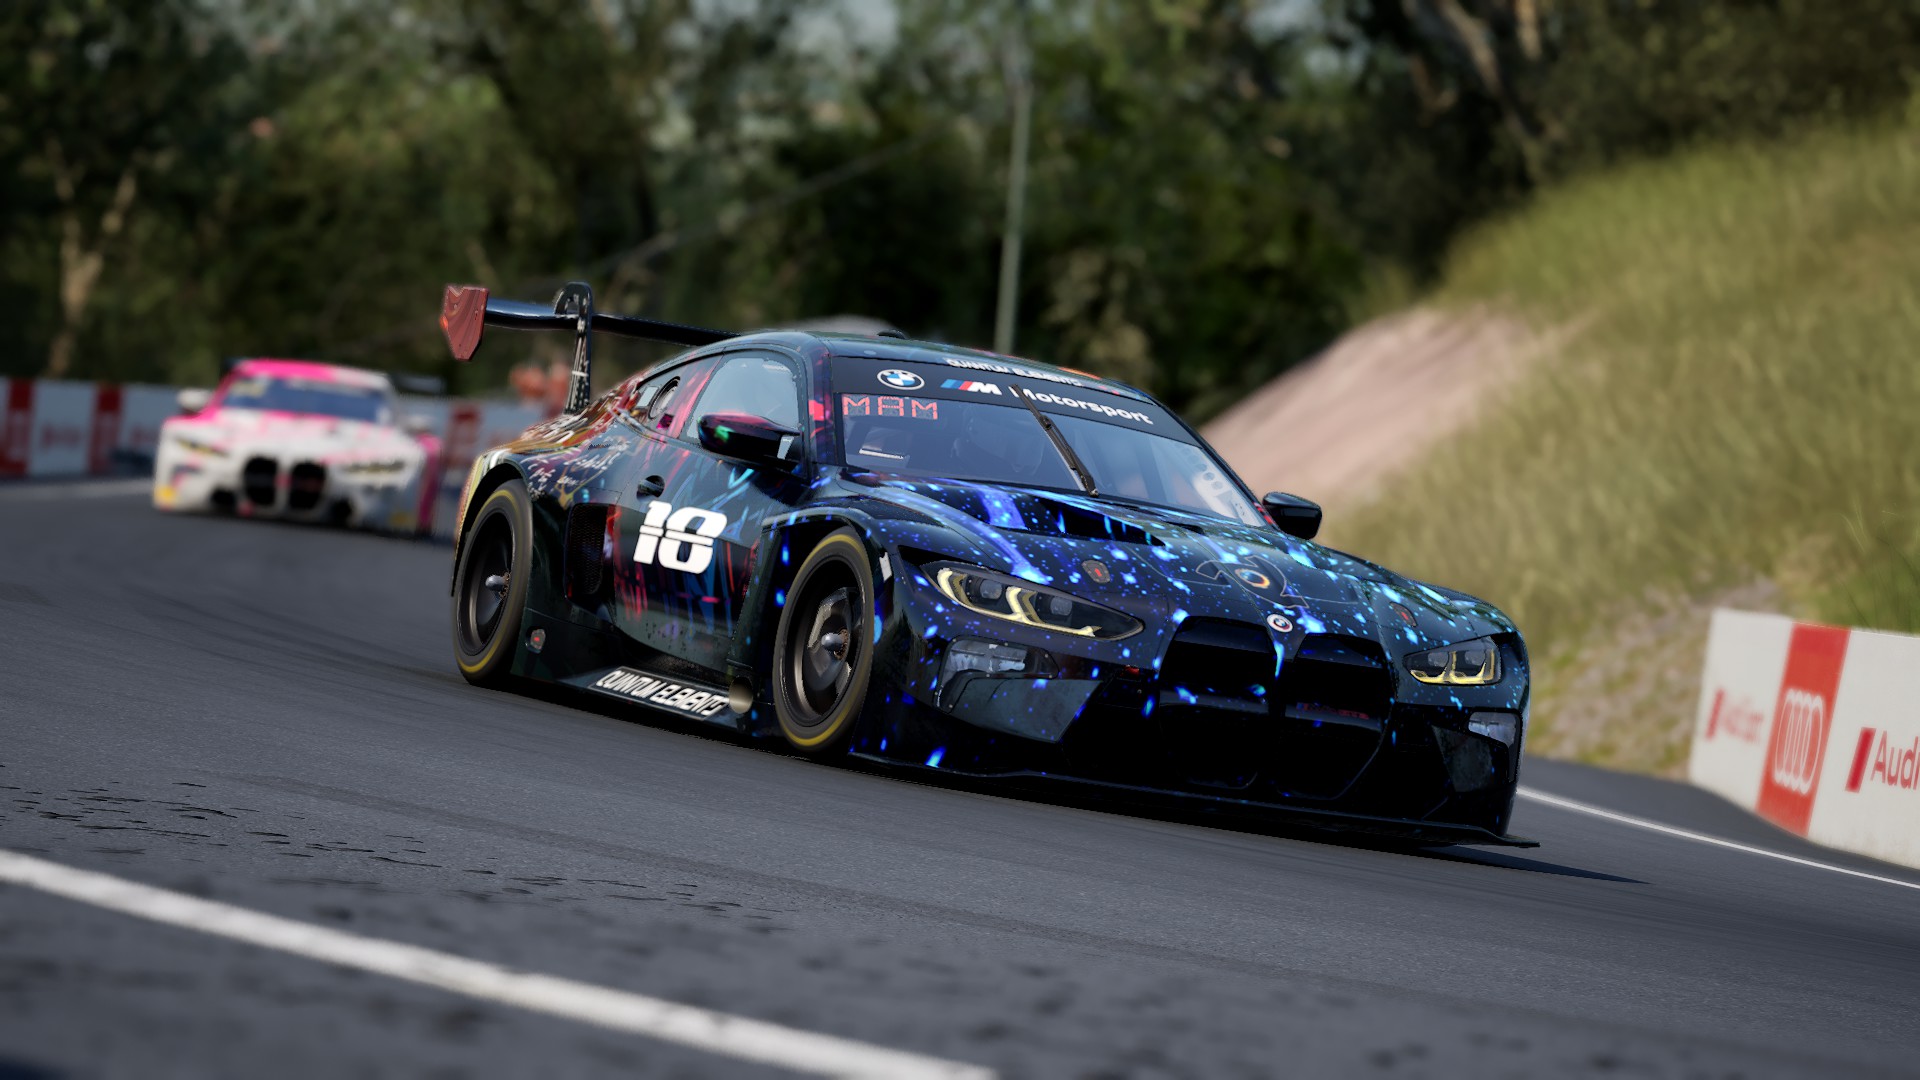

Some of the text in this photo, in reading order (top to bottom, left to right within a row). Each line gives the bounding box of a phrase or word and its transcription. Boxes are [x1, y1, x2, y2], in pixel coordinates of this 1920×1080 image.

[965, 381, 1002, 396] M
[842, 395, 938, 420] MAM
[633, 500, 728, 574] 18
